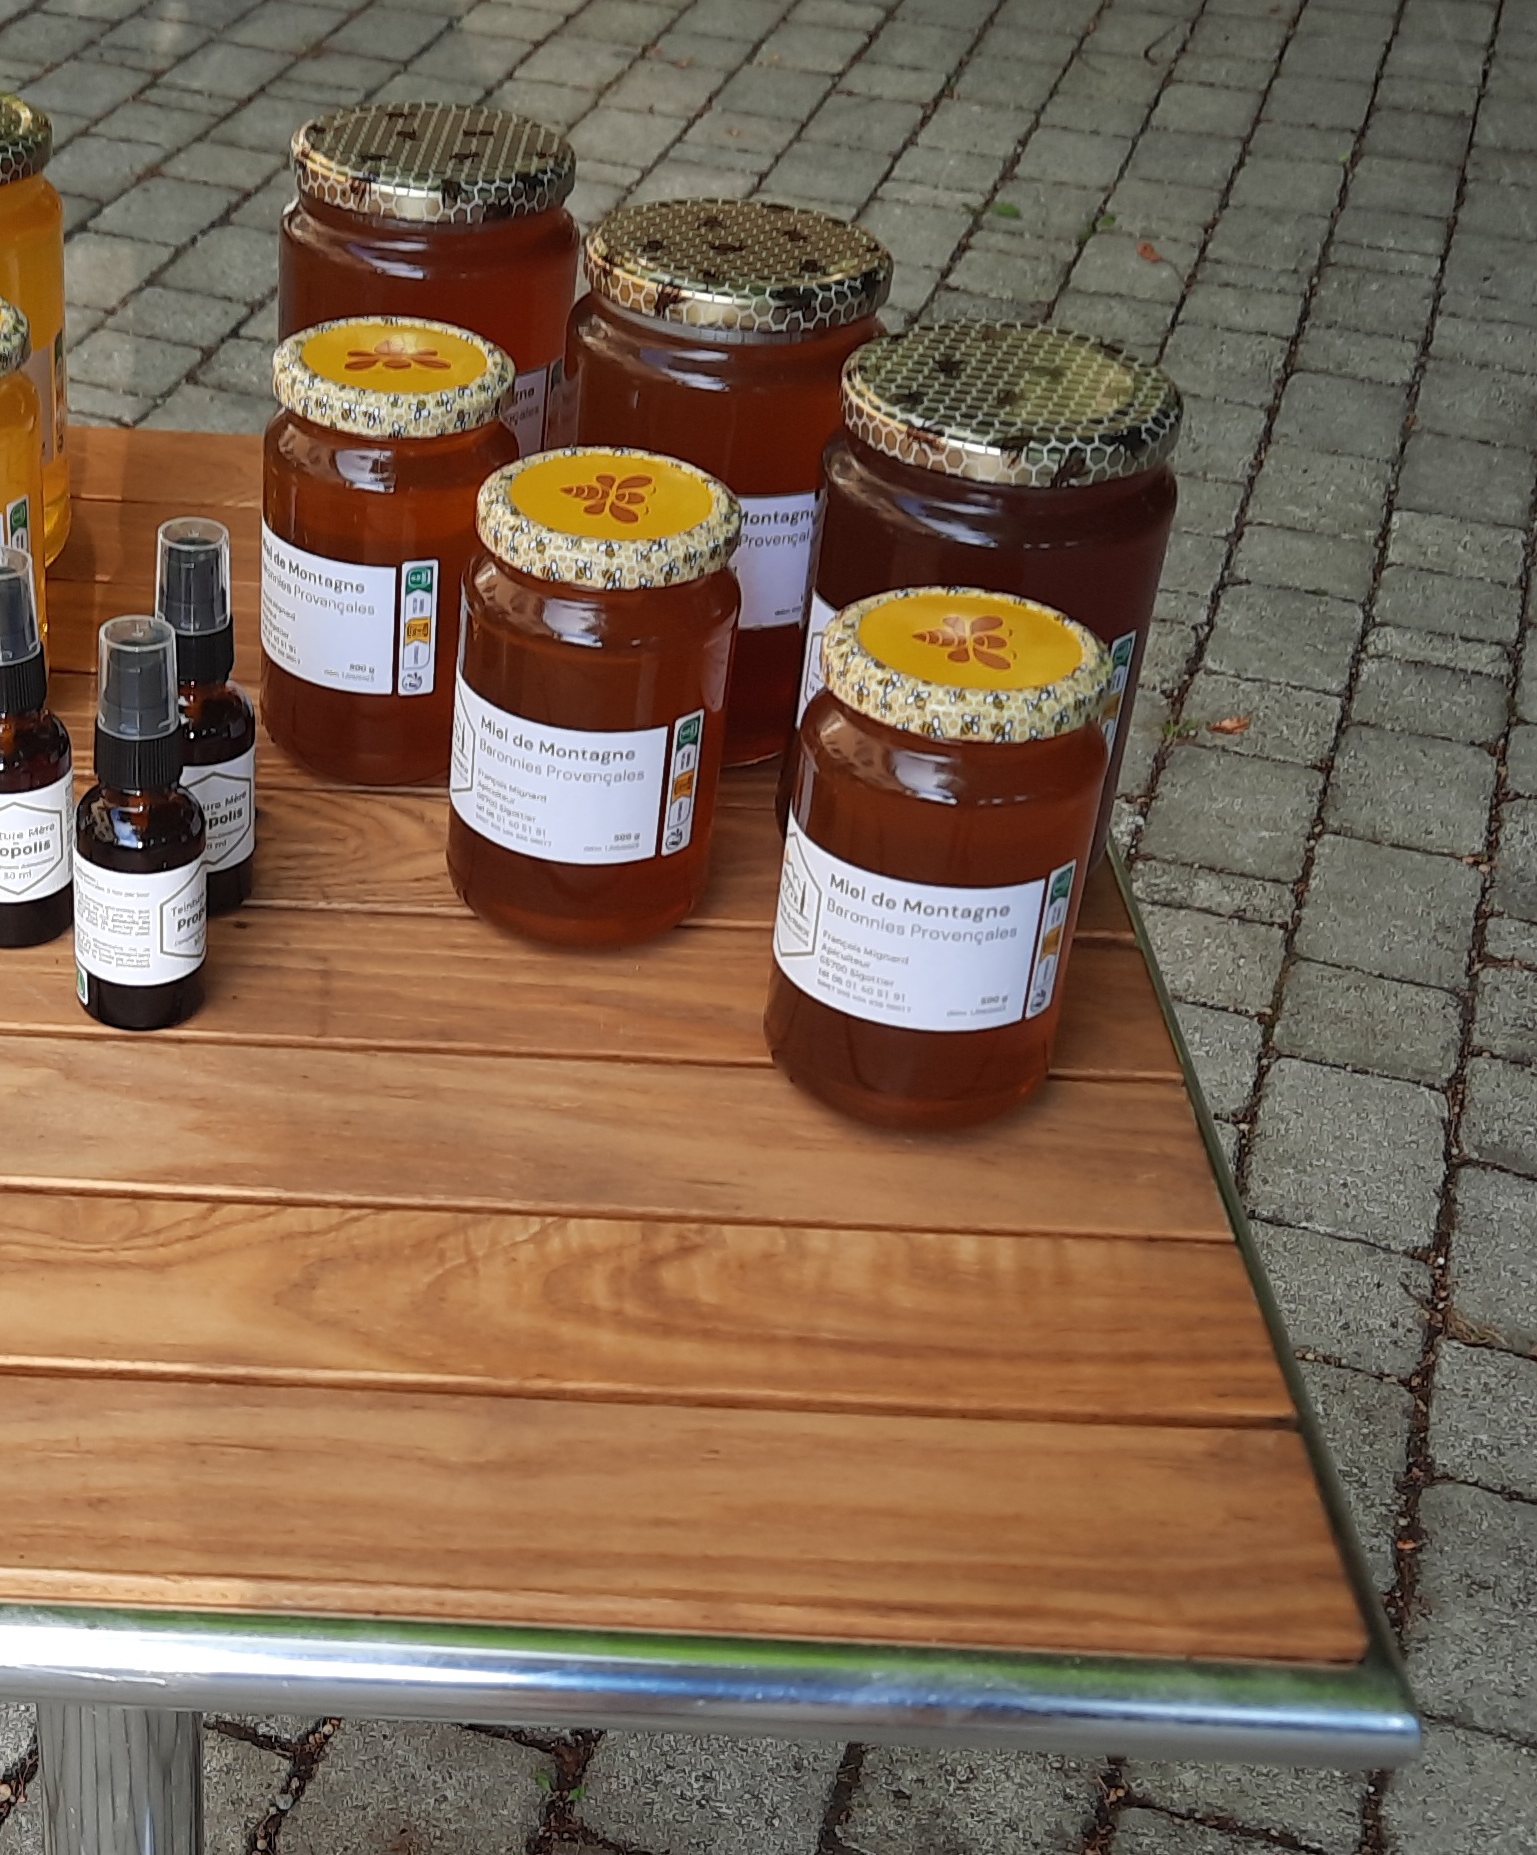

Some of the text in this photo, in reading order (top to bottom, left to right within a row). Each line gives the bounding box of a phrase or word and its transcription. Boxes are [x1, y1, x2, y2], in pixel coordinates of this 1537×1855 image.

[739, 528, 810, 549] Provençal
[274, 551, 365, 594] de Montagne
[294, 584, 375, 615] Provençales
[480, 715, 635, 766] Miel de Montagne
[480, 737, 542, 775] Baronnies
[546, 764, 645, 786] Provençales
[28, 823, 55, 838] Mère
[208, 807, 243, 830] polis
[830, 873, 1011, 923] Miel de Montagne
[827, 898, 905, 936] Baronnies
[910, 924, 1018, 945] Provençales
